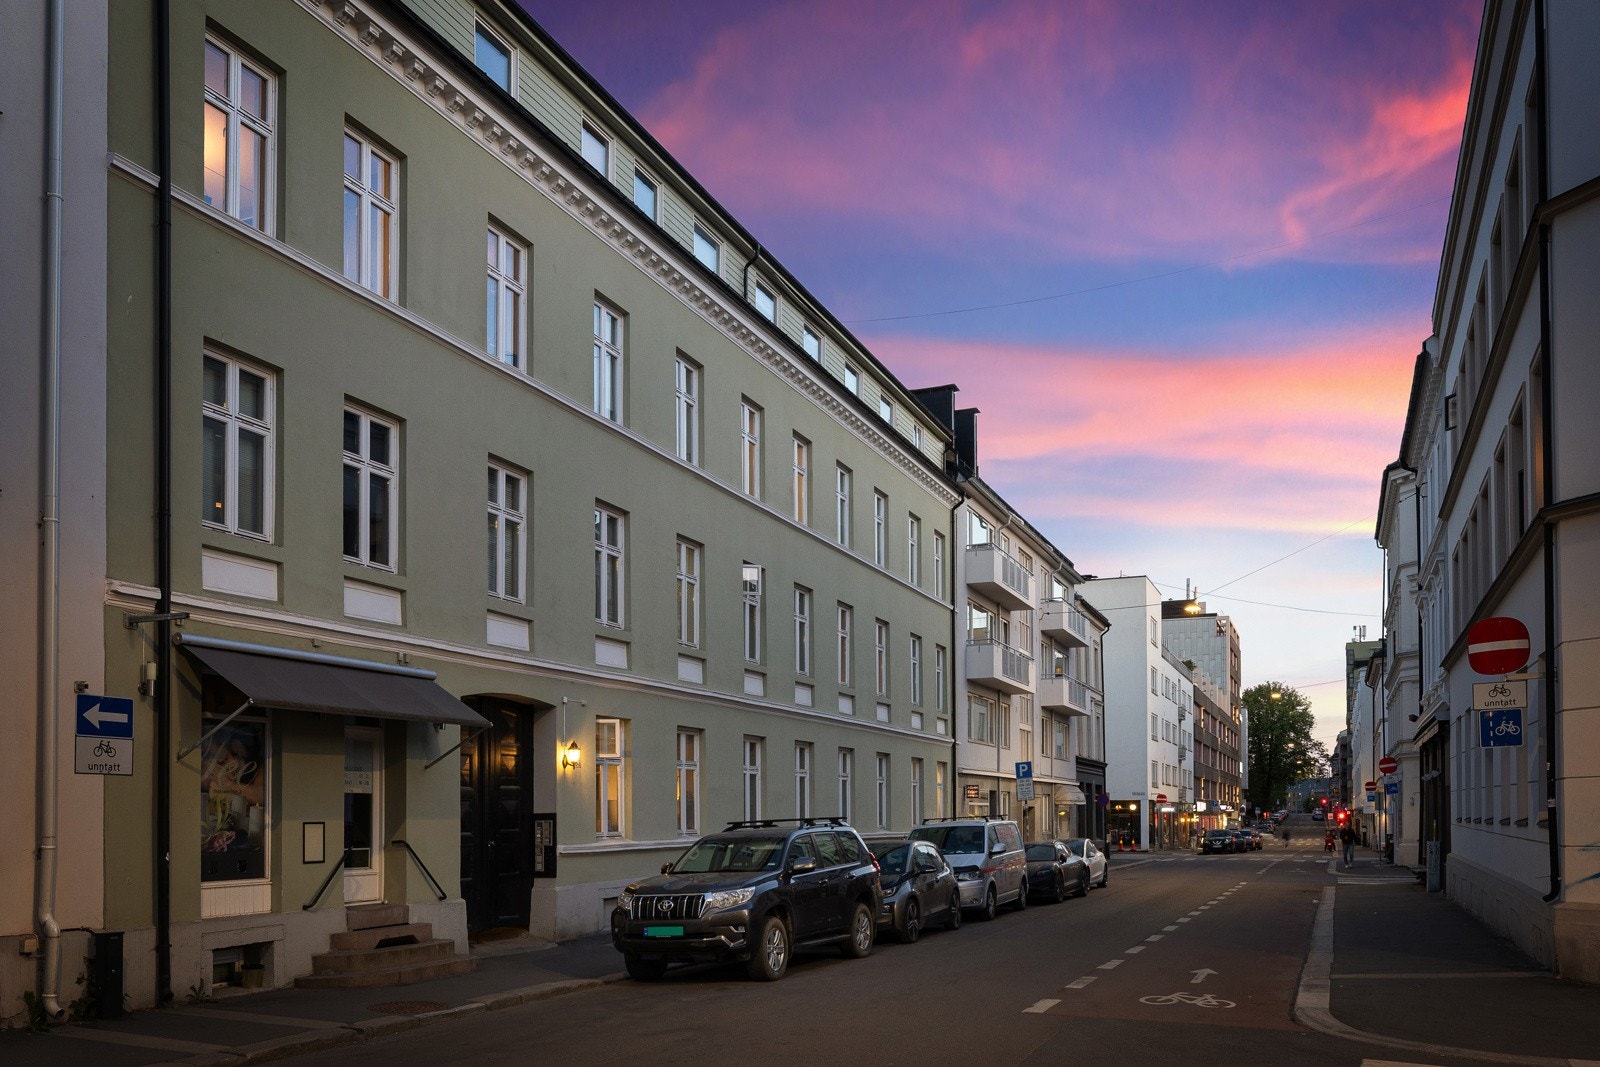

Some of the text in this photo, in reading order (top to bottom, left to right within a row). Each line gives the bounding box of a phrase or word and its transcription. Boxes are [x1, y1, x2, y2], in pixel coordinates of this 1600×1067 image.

[1484, 699, 1517, 707] unntatt
[88, 763, 121, 772] unntatt
[1019, 764, 1028, 777] P
